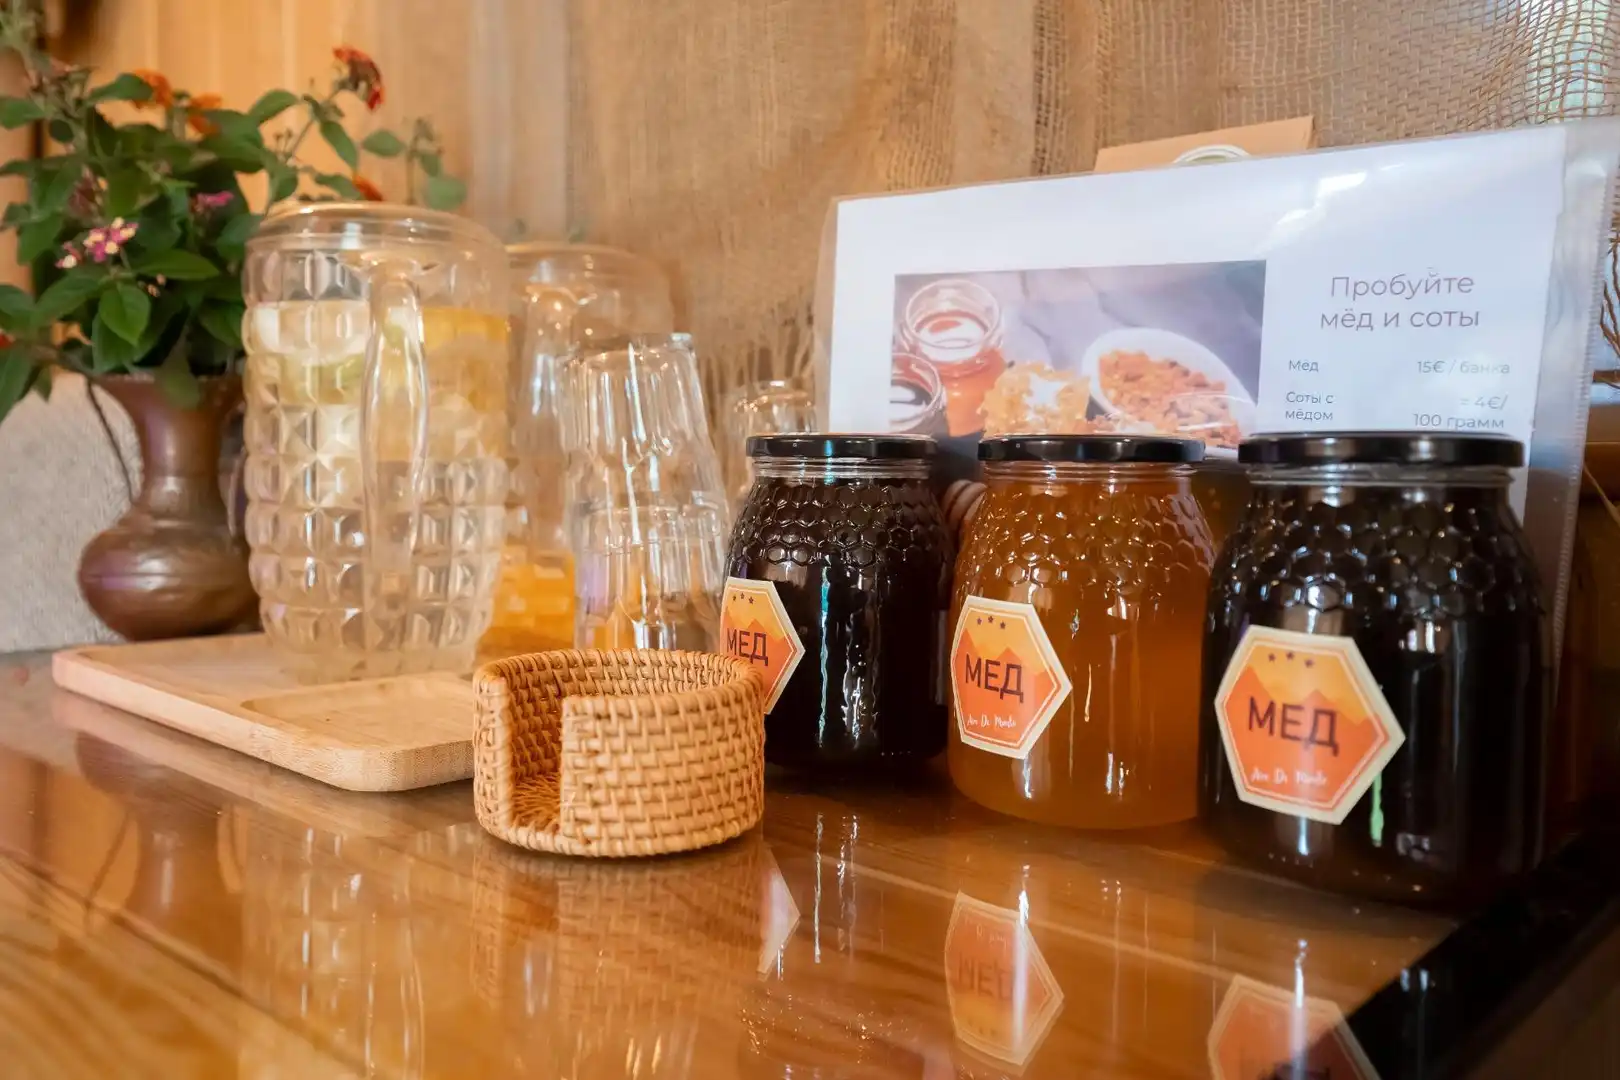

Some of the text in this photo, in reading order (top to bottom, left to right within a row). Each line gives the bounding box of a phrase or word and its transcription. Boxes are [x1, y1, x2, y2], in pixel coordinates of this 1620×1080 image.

[1331, 271, 1475, 301] Пробуйте
[1320, 308, 1480, 331] мёд и соты
[1417, 360, 1446, 374] 15€
[1460, 361, 1510, 374] банка
[1285, 391, 1335, 404] Соты с
[1285, 408, 1333, 421] мёдом
[1412, 413, 1505, 430] 100 грамм
[726, 628, 769, 667] МЕД
[965, 653, 1024, 704] МЕД
[1248, 696, 1340, 758] МЕД
